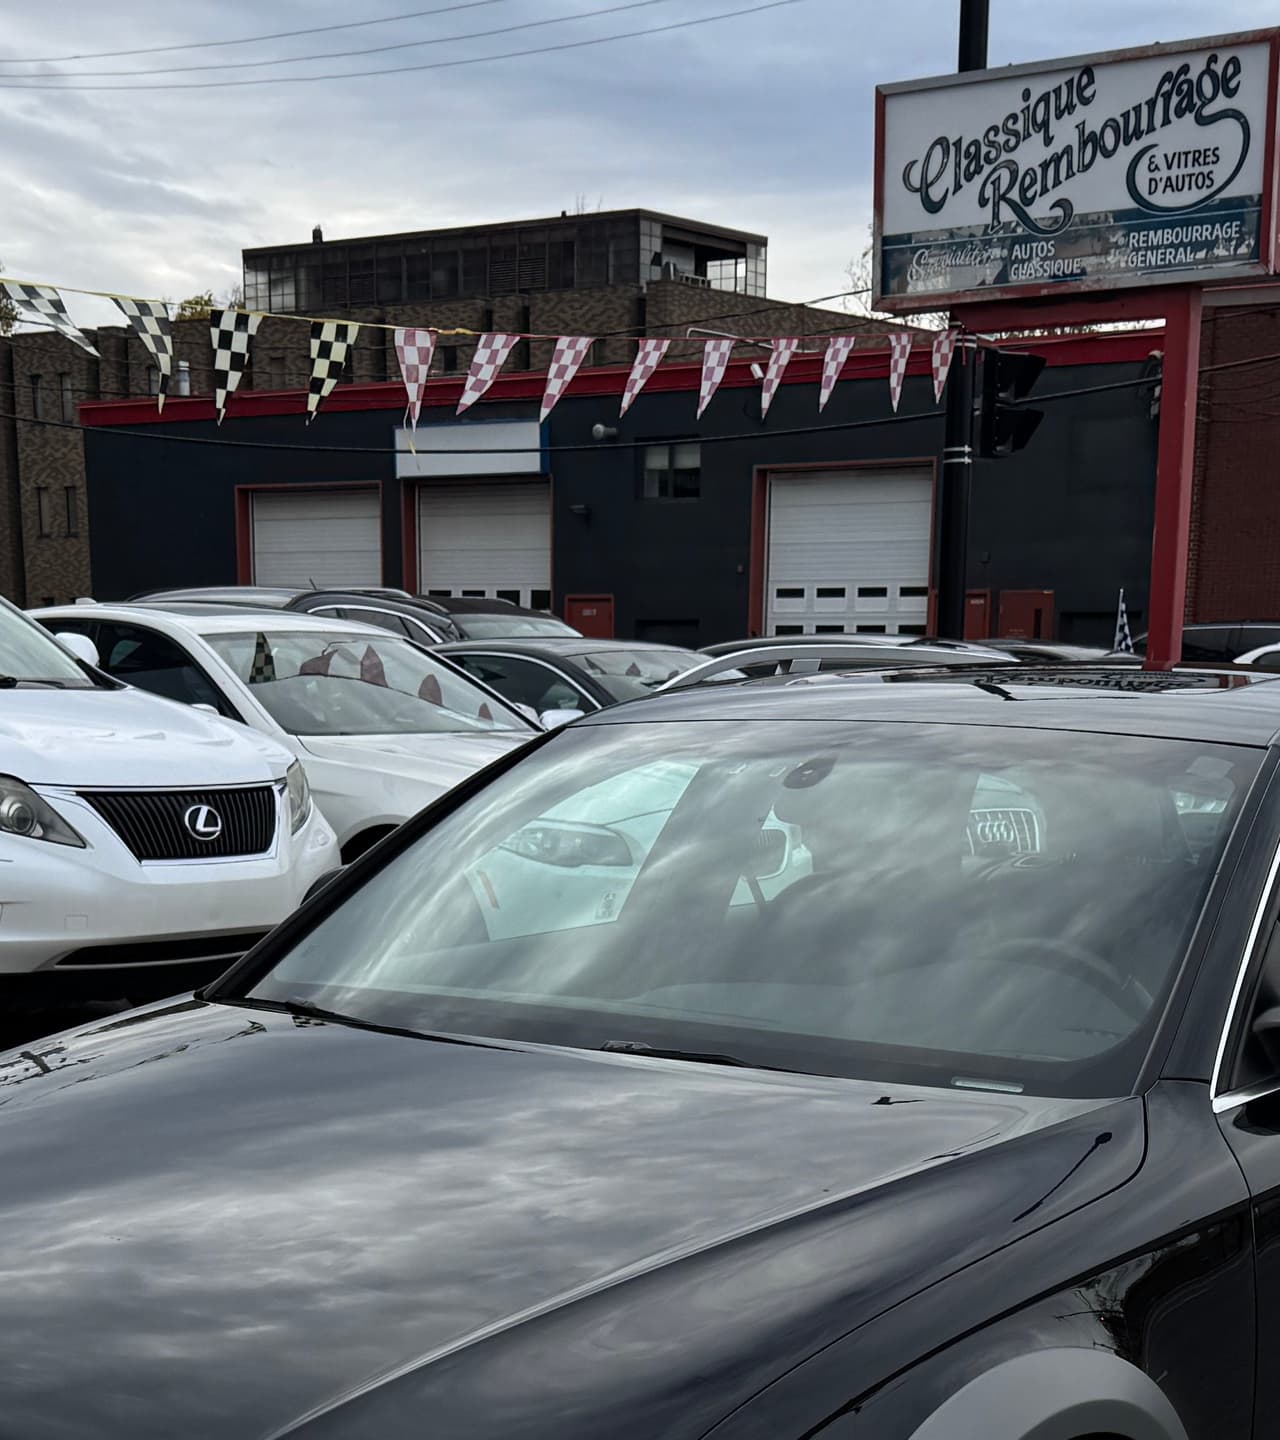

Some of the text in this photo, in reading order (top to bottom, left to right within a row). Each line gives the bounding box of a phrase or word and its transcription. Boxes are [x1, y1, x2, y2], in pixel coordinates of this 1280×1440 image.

[902, 65, 1097, 214] Classique
[1147, 146, 1221, 174] & VITRES
[1148, 169, 1215, 196] D'AUTOS
[1129, 220, 1241, 249] REMBOURRAGE
[1011, 239, 1056, 261] AUTOS
